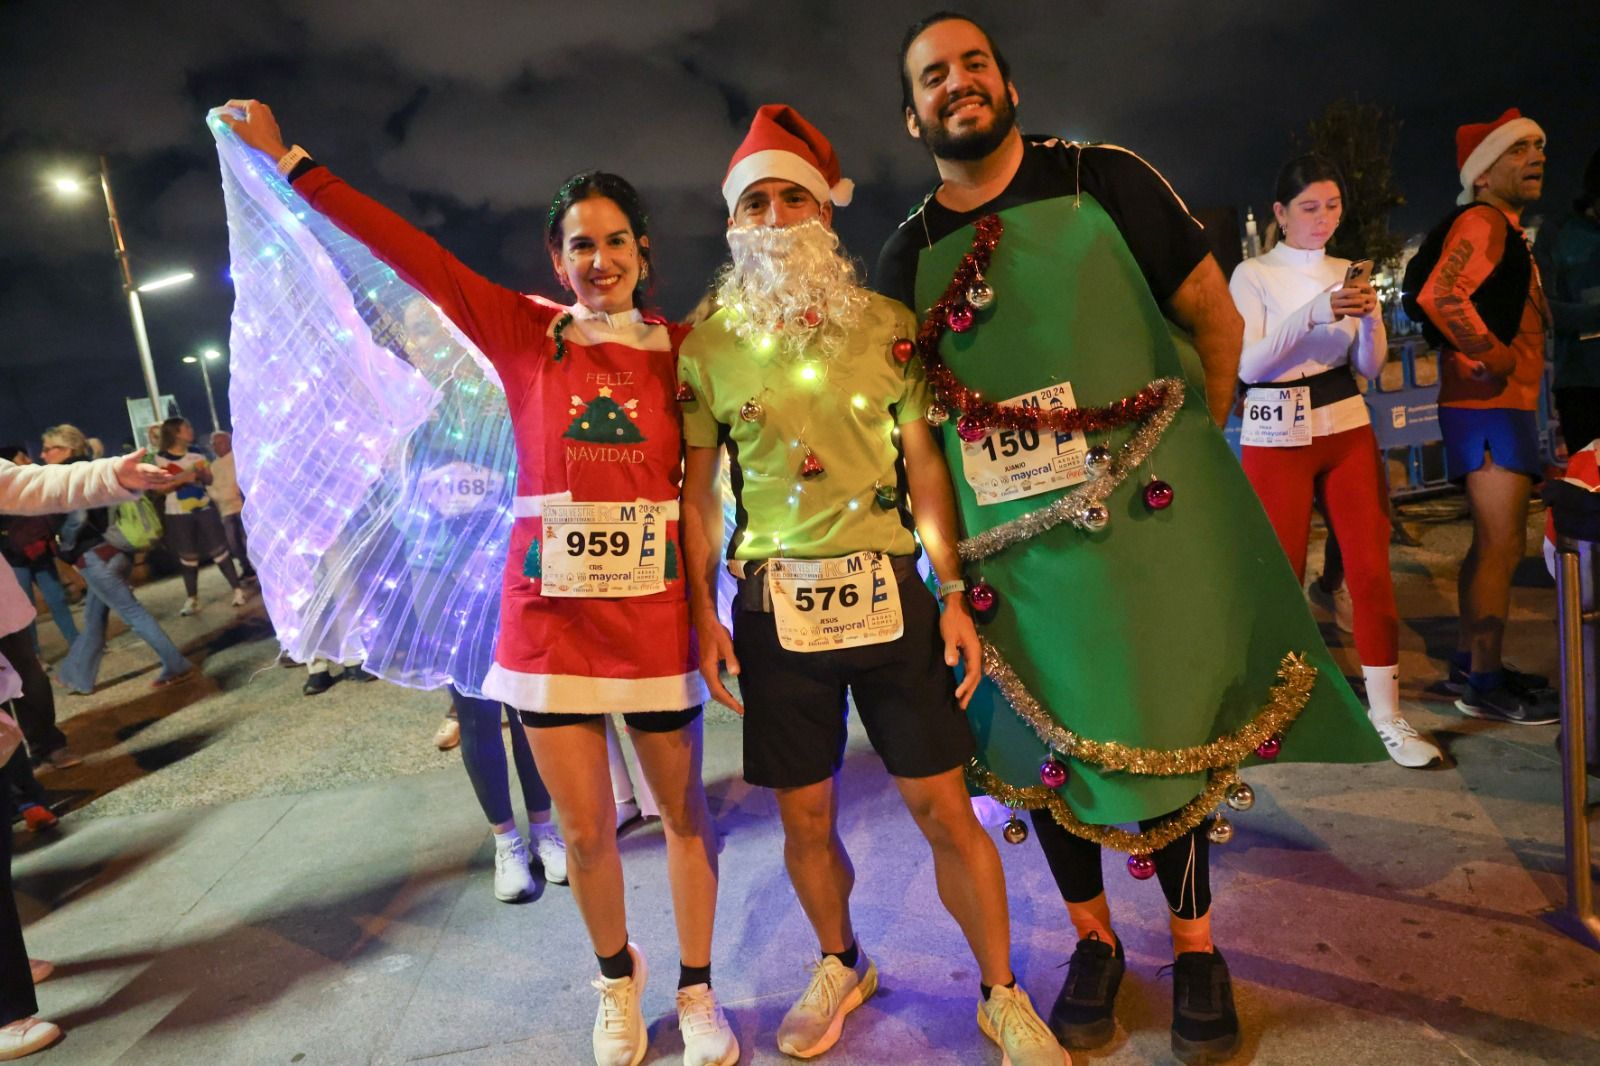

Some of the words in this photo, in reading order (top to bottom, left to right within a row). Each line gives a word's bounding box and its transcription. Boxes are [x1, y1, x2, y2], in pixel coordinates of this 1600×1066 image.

[586, 371, 634, 386] FELIZ
[1041, 387, 1065, 400] 2024
[1250, 405, 1283, 421] 661
[982, 429, 1040, 461] 150
[567, 446, 645, 464] NAVIDAD
[1011, 463, 1052, 483] mayoral
[638, 504, 661, 514] 2024
[567, 531, 629, 556] 959
[589, 571, 632, 583] mayoral
[795, 584, 859, 612] 576
[823, 619, 865, 634] mayoral
